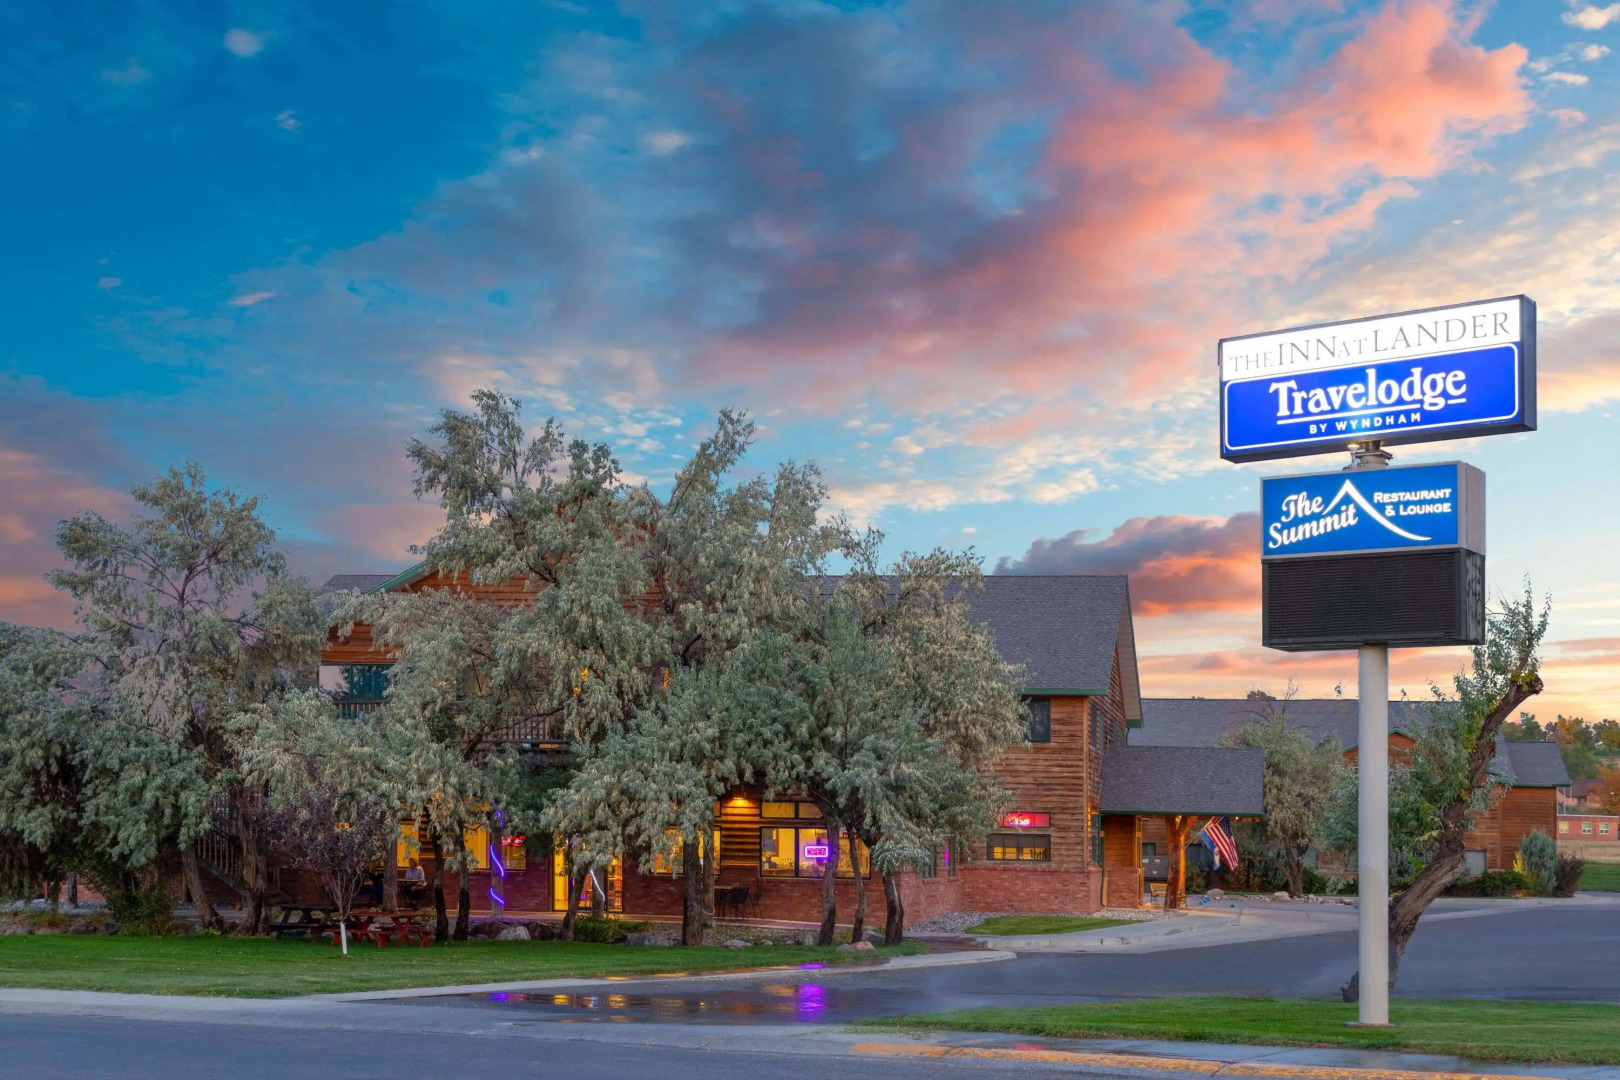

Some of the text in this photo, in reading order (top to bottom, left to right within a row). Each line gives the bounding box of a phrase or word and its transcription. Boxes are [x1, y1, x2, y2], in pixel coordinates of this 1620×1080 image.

[1230, 312, 1511, 371] THE INN AT LANDER
[1269, 367, 1467, 417] Travelodge
[1309, 412, 1422, 434] BY WYNDHAM
[1281, 491, 1324, 523] The
[1373, 488, 1452, 503] RESTAURANT
[1385, 502, 1452, 517] & LOUNGE
[1268, 503, 1359, 549] Summit
